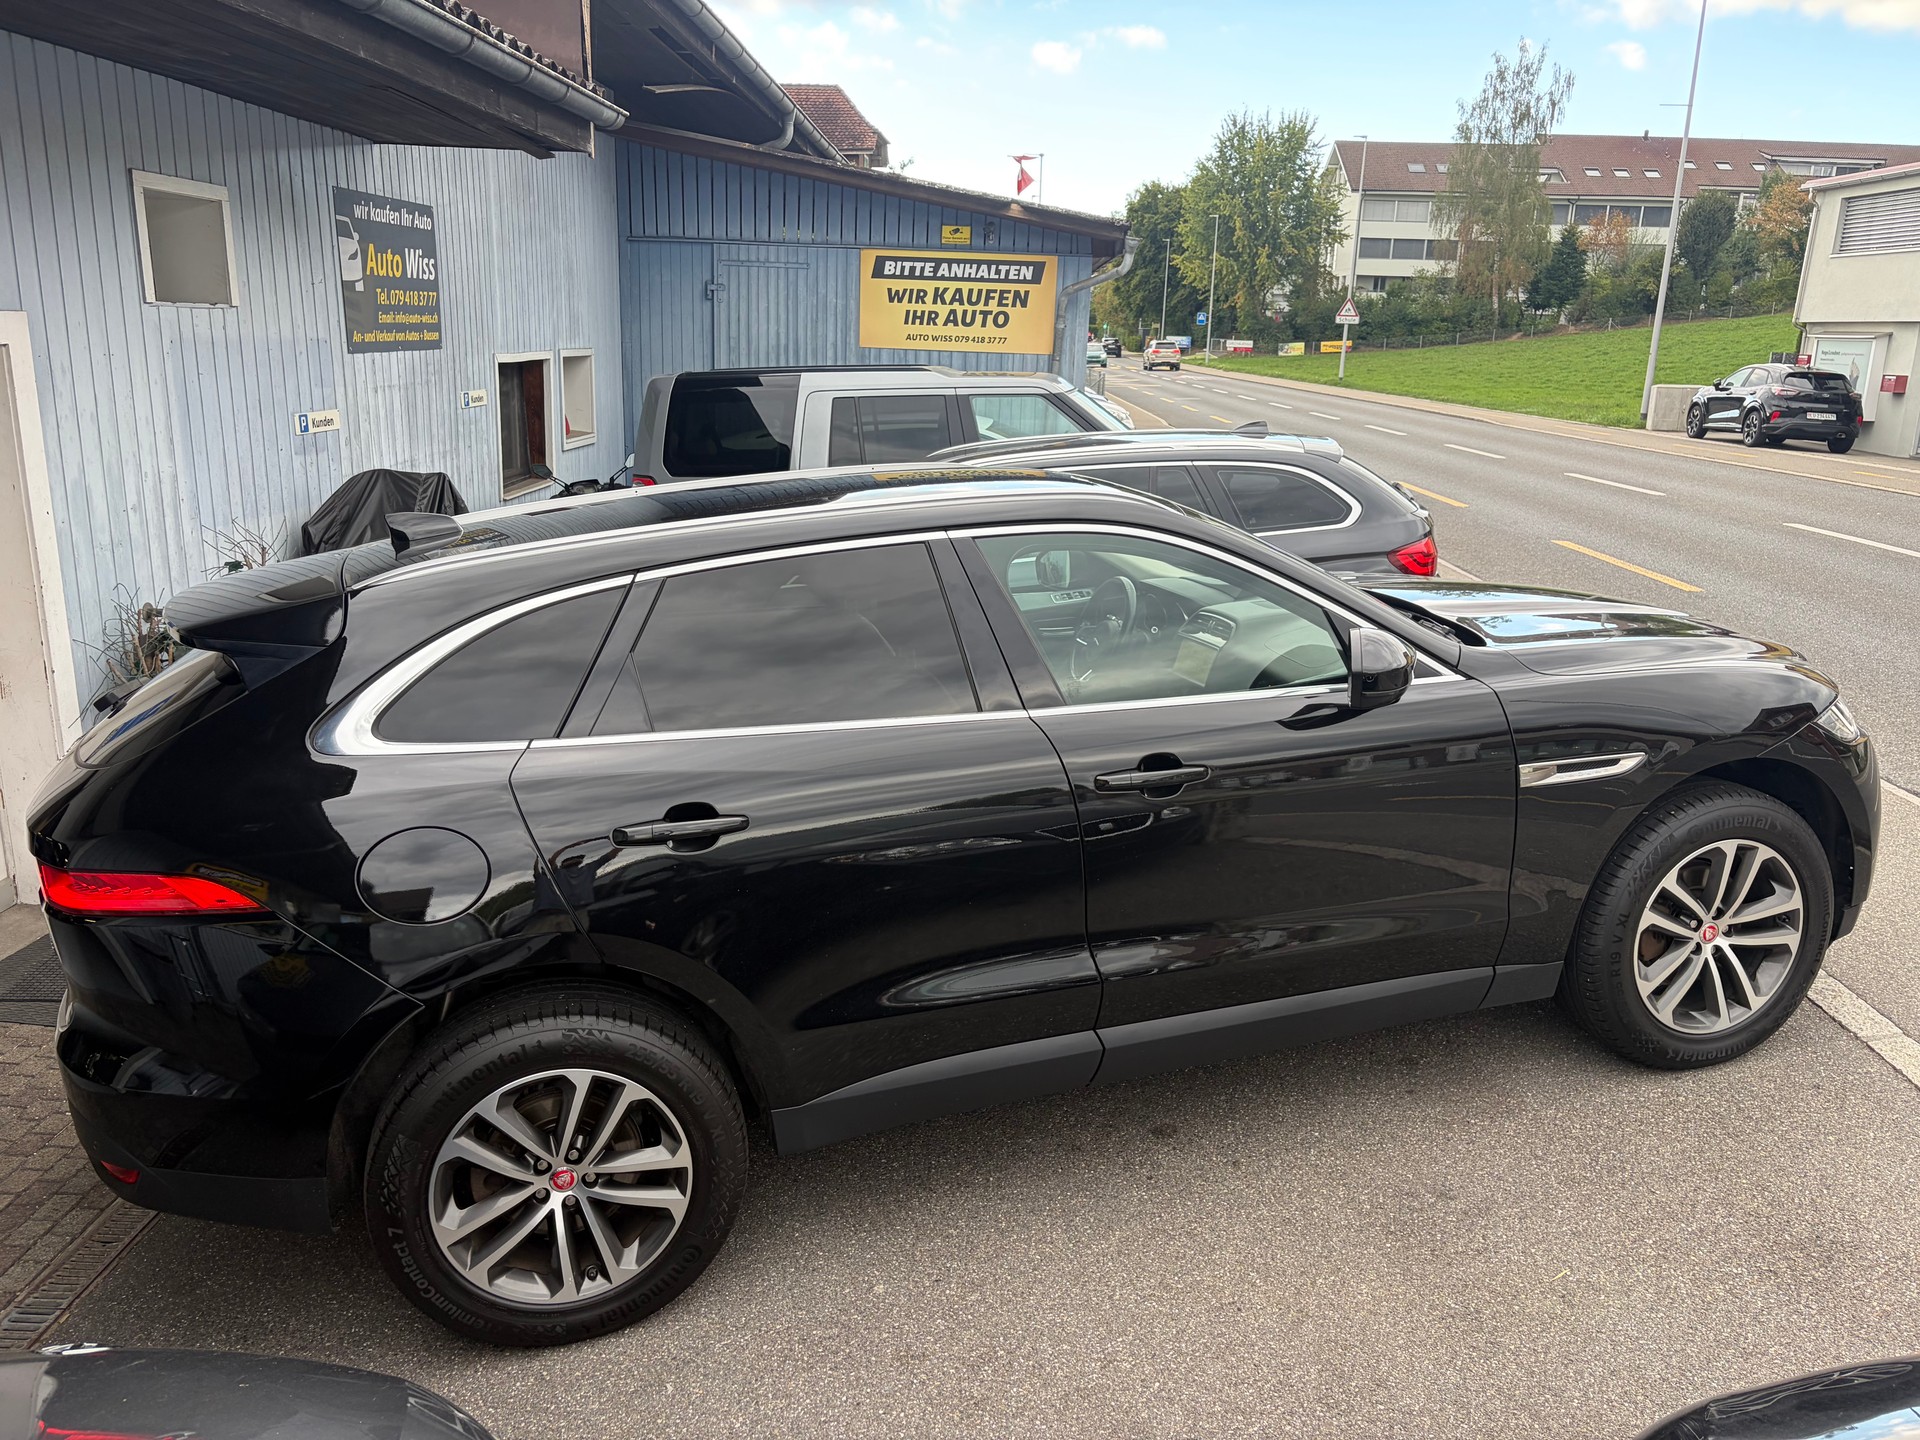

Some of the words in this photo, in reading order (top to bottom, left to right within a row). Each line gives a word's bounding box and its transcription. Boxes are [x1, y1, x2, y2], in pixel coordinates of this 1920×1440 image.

[354, 201, 368, 219] wir
[370, 202, 399, 225] kaufen
[401, 208, 413, 227] Ihr
[414, 211, 432, 230] Auto
[366, 243, 402, 278] Auto
[404, 248, 435, 280] Wiss
[883, 260, 933, 277] BITTE
[937, 263, 1034, 280] ANHALTEN
[376, 288, 389, 305] Tel.
[390, 289, 404, 305] 079
[405, 291, 418, 306] 418
[419, 291, 428, 306] 37
[428, 291, 437, 306] 77
[887, 287, 928, 305] WIR
[932, 287, 1030, 308] KAUFEN
[903, 309, 939, 326] IHR
[942, 308, 1010, 329] AUTO
[905, 333, 929, 342] AUTO
[931, 334, 953, 343] WISS
[954, 335, 970, 343] 079
[970, 336, 985, 344] 418
[987, 336, 997, 344] 37
[997, 337, 1007, 345] 77
[471, 394, 484, 404] Kunden
[311, 415, 335, 429] Kunden
[418, 1043, 528, 1130] ontinental
[393, 1241, 496, 1331] remiumContact
